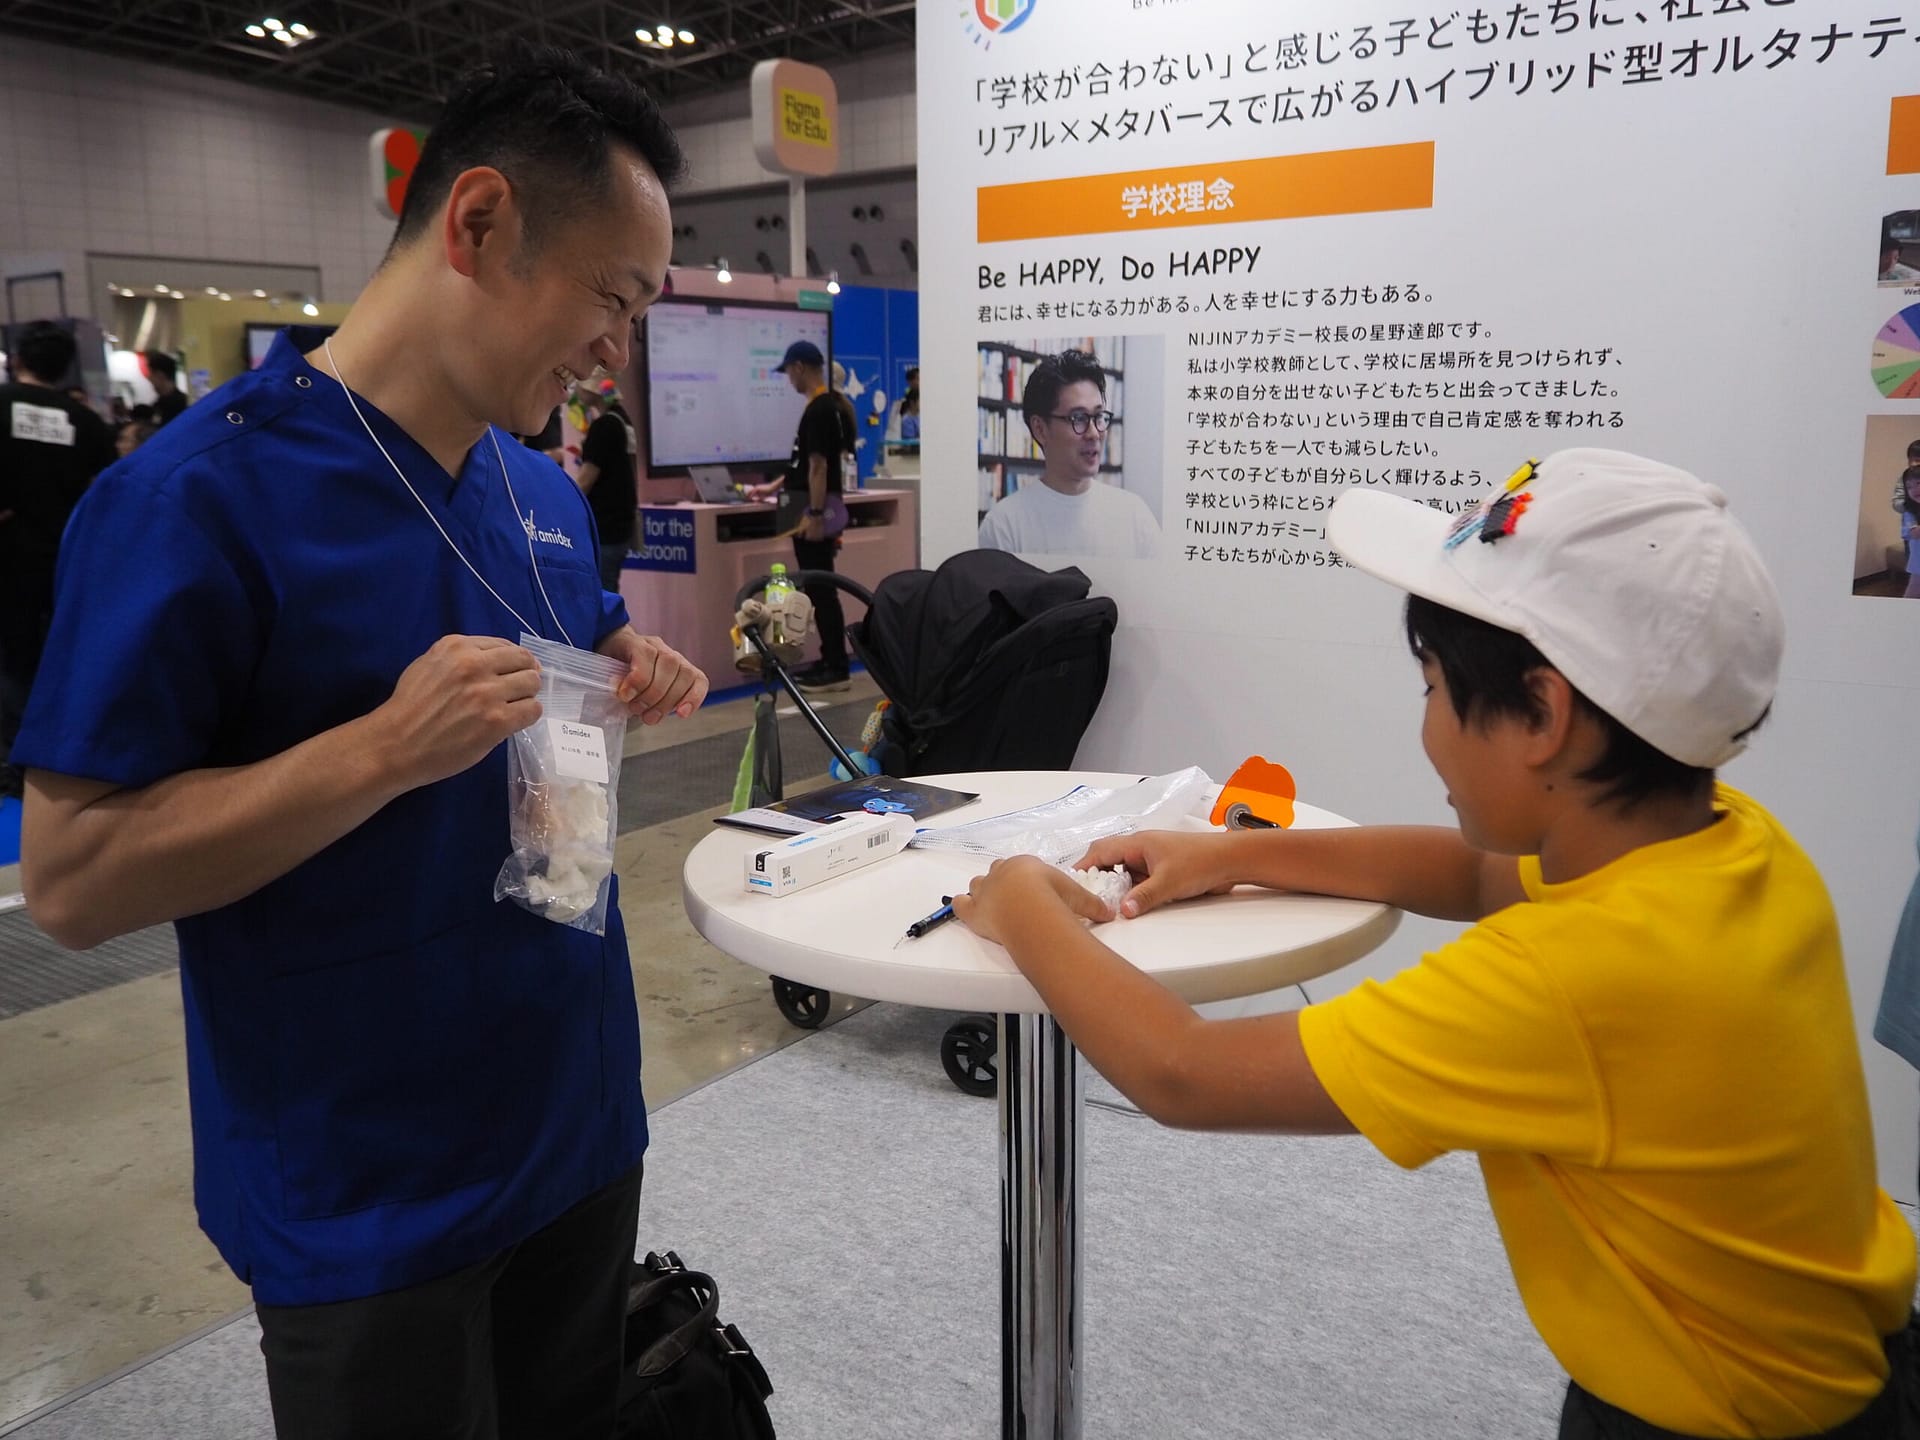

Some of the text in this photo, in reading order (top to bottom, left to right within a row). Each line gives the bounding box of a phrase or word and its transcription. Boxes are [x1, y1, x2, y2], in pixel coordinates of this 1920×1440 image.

[975, 0, 1796, 109] 「学校が合わない」と感じる子どもたちに、社
[977, 17, 1920, 156] リアル×メタバースで広がるハイブリッド型オルタナテ
[786, 94, 820, 119] Figma
[1120, 177, 1236, 218] 学校理念
[978, 246, 1262, 289] Be HAPPY, Do HAPPY
[977, 284, 1433, 323] 君には、幸せになる力がある。人を幸せにする力もある。
[1188, 321, 1492, 346] NIJINアカデミー校長の星野達郎です。
[1187, 347, 1623, 375] 私は小学校教師として、学校に居場所を見つけられず、
[1187, 379, 1619, 401] 本来の自分を出せない子どもたちと出会ってきました。
[1186, 409, 1625, 429] 「学校が合わない」という理由で自己肯定感を奪われる
[1186, 439, 1439, 457] 子どもたちを一人でも減らしたい。
[1186, 466, 1493, 487] すべての子どもが自分らしく輝けるよう、
[645, 516, 693, 538] for the
[1186, 518, 1326, 540] 「NIJINアカデミー」
[1184, 545, 1357, 569] 子どもたちが心から笑
